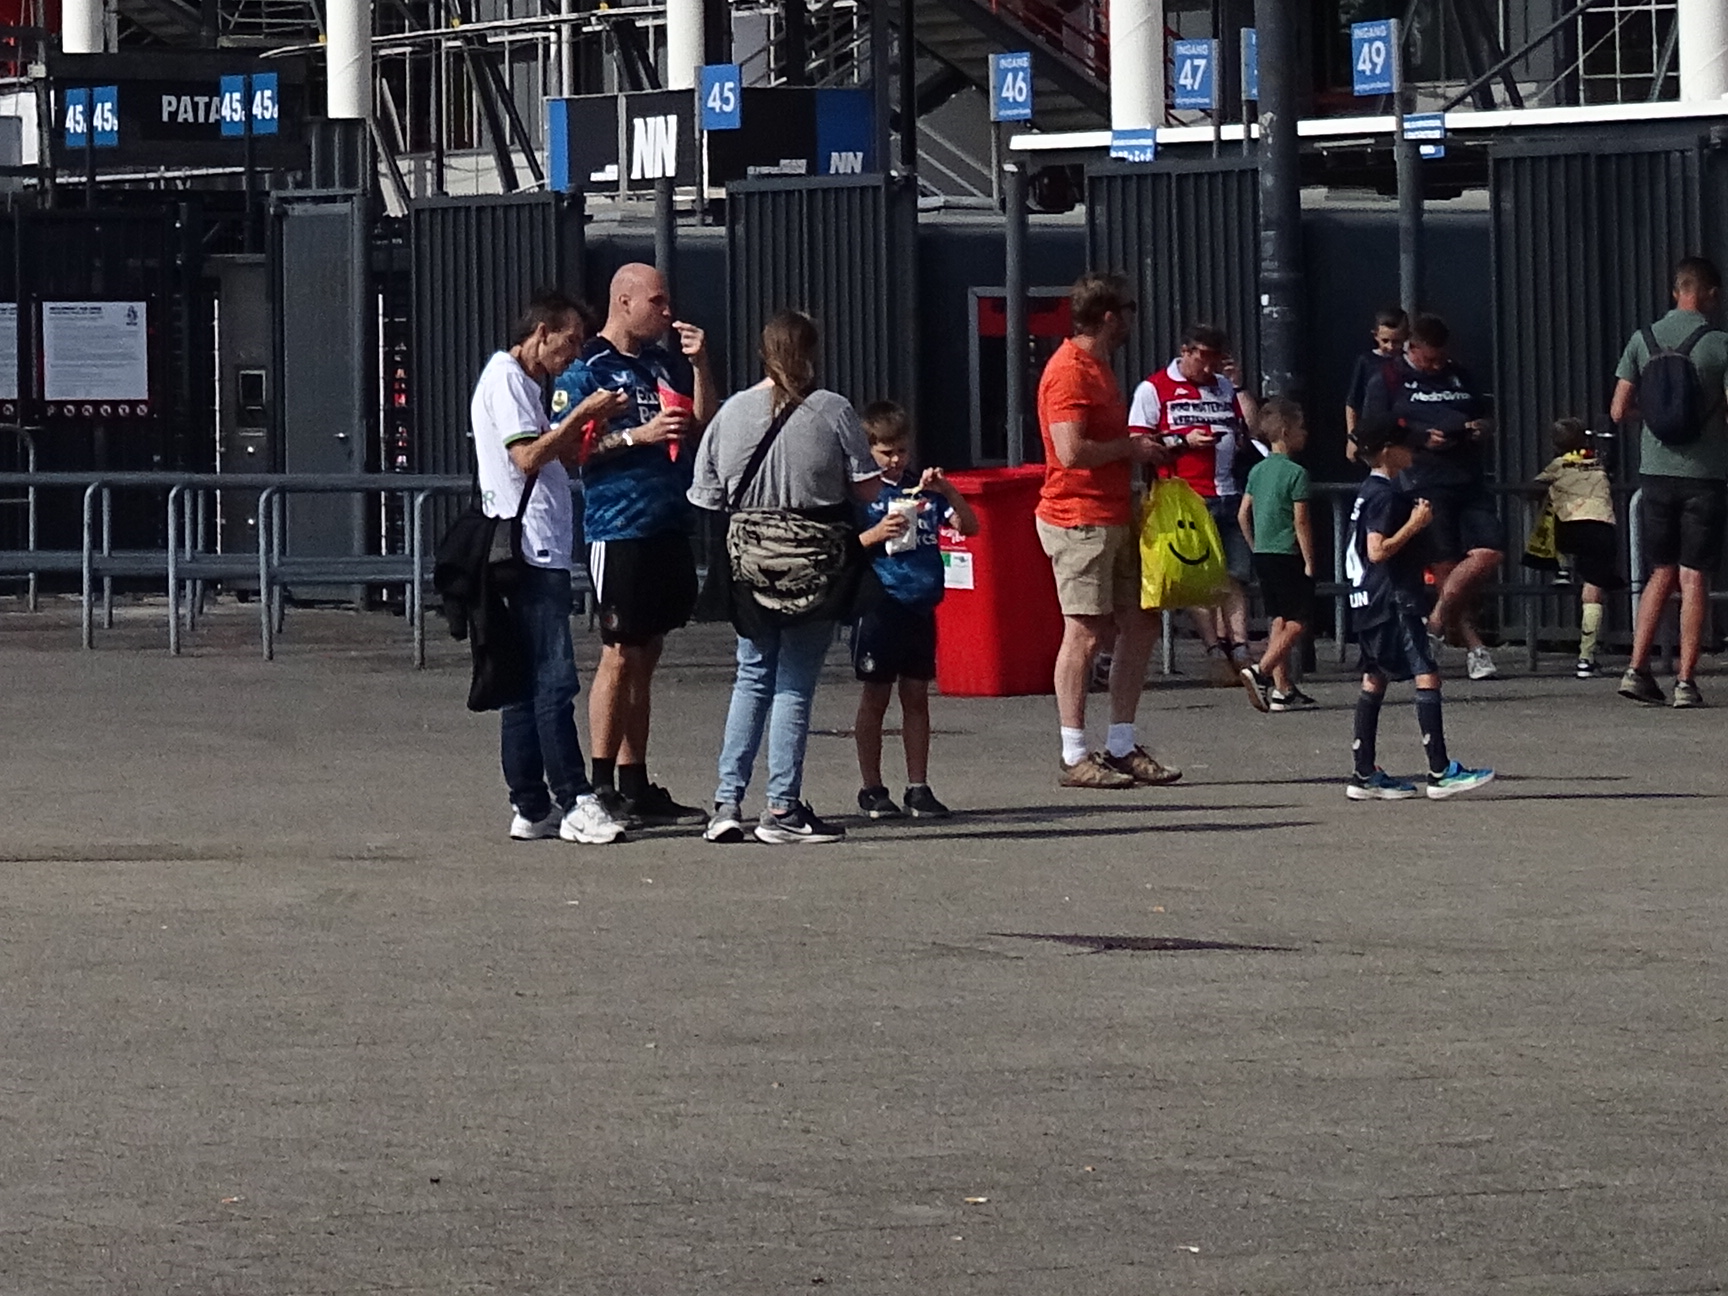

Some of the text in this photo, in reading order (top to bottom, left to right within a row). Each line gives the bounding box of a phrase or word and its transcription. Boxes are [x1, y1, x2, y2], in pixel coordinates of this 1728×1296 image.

[1357, 40, 1387, 76] 49
[1001, 72, 1027, 102] 46
[1179, 58, 1208, 91] 47
[707, 82, 736, 112] 45
[631, 114, 678, 179] NN
[828, 152, 864, 174] NN
